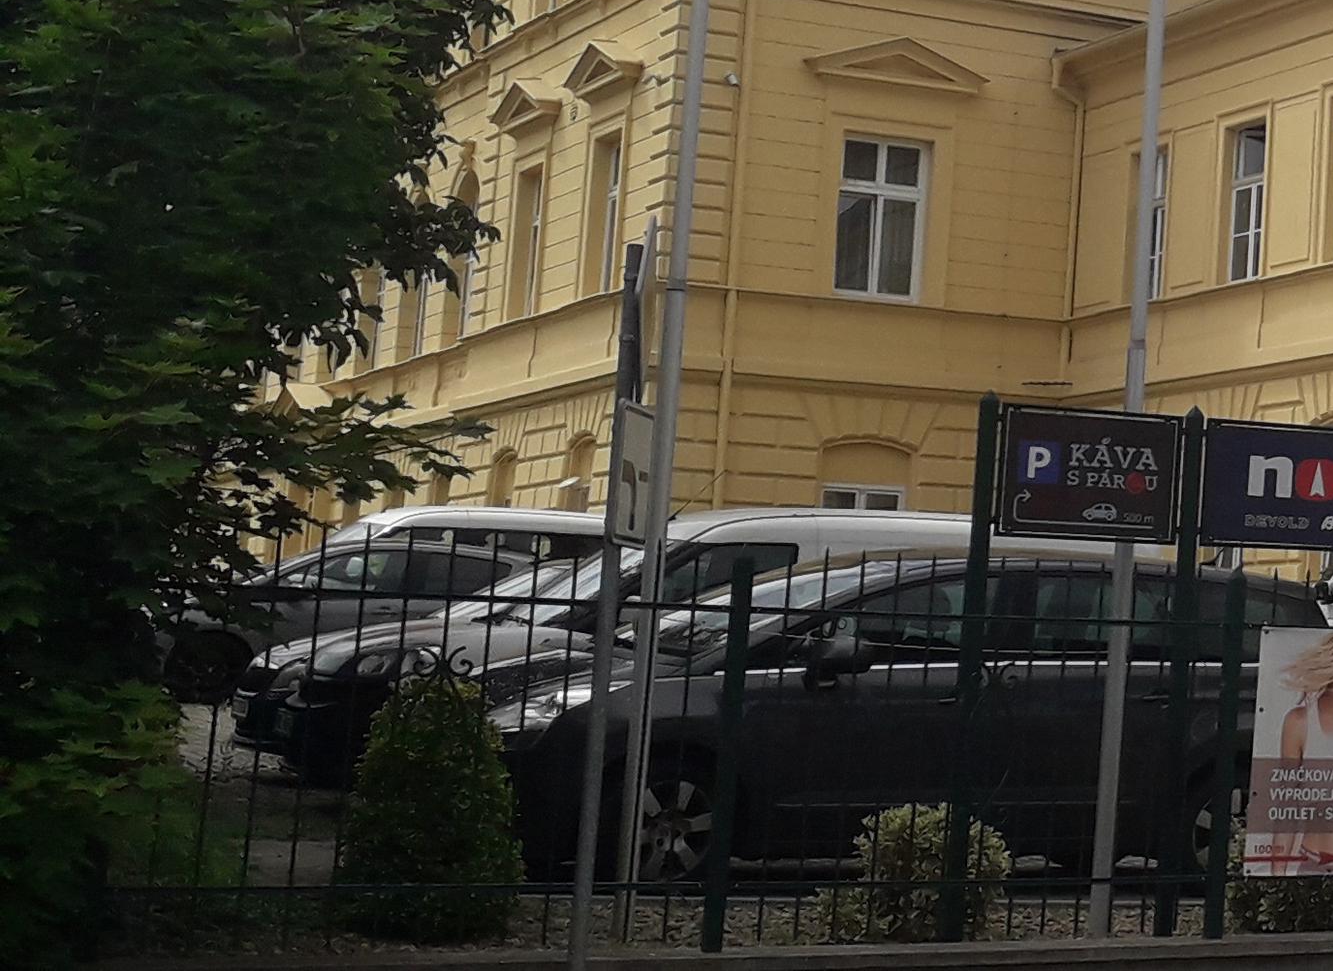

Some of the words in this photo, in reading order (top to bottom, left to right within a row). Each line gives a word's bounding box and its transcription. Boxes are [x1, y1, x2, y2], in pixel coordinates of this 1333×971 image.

[1068, 436, 1158, 471] KÁVA
[1027, 446, 1051, 479] P
[1067, 470, 1080, 486] S
[1244, 513, 1311, 530] DEVOLD
[1268, 806, 1315, 821] OUTLET
